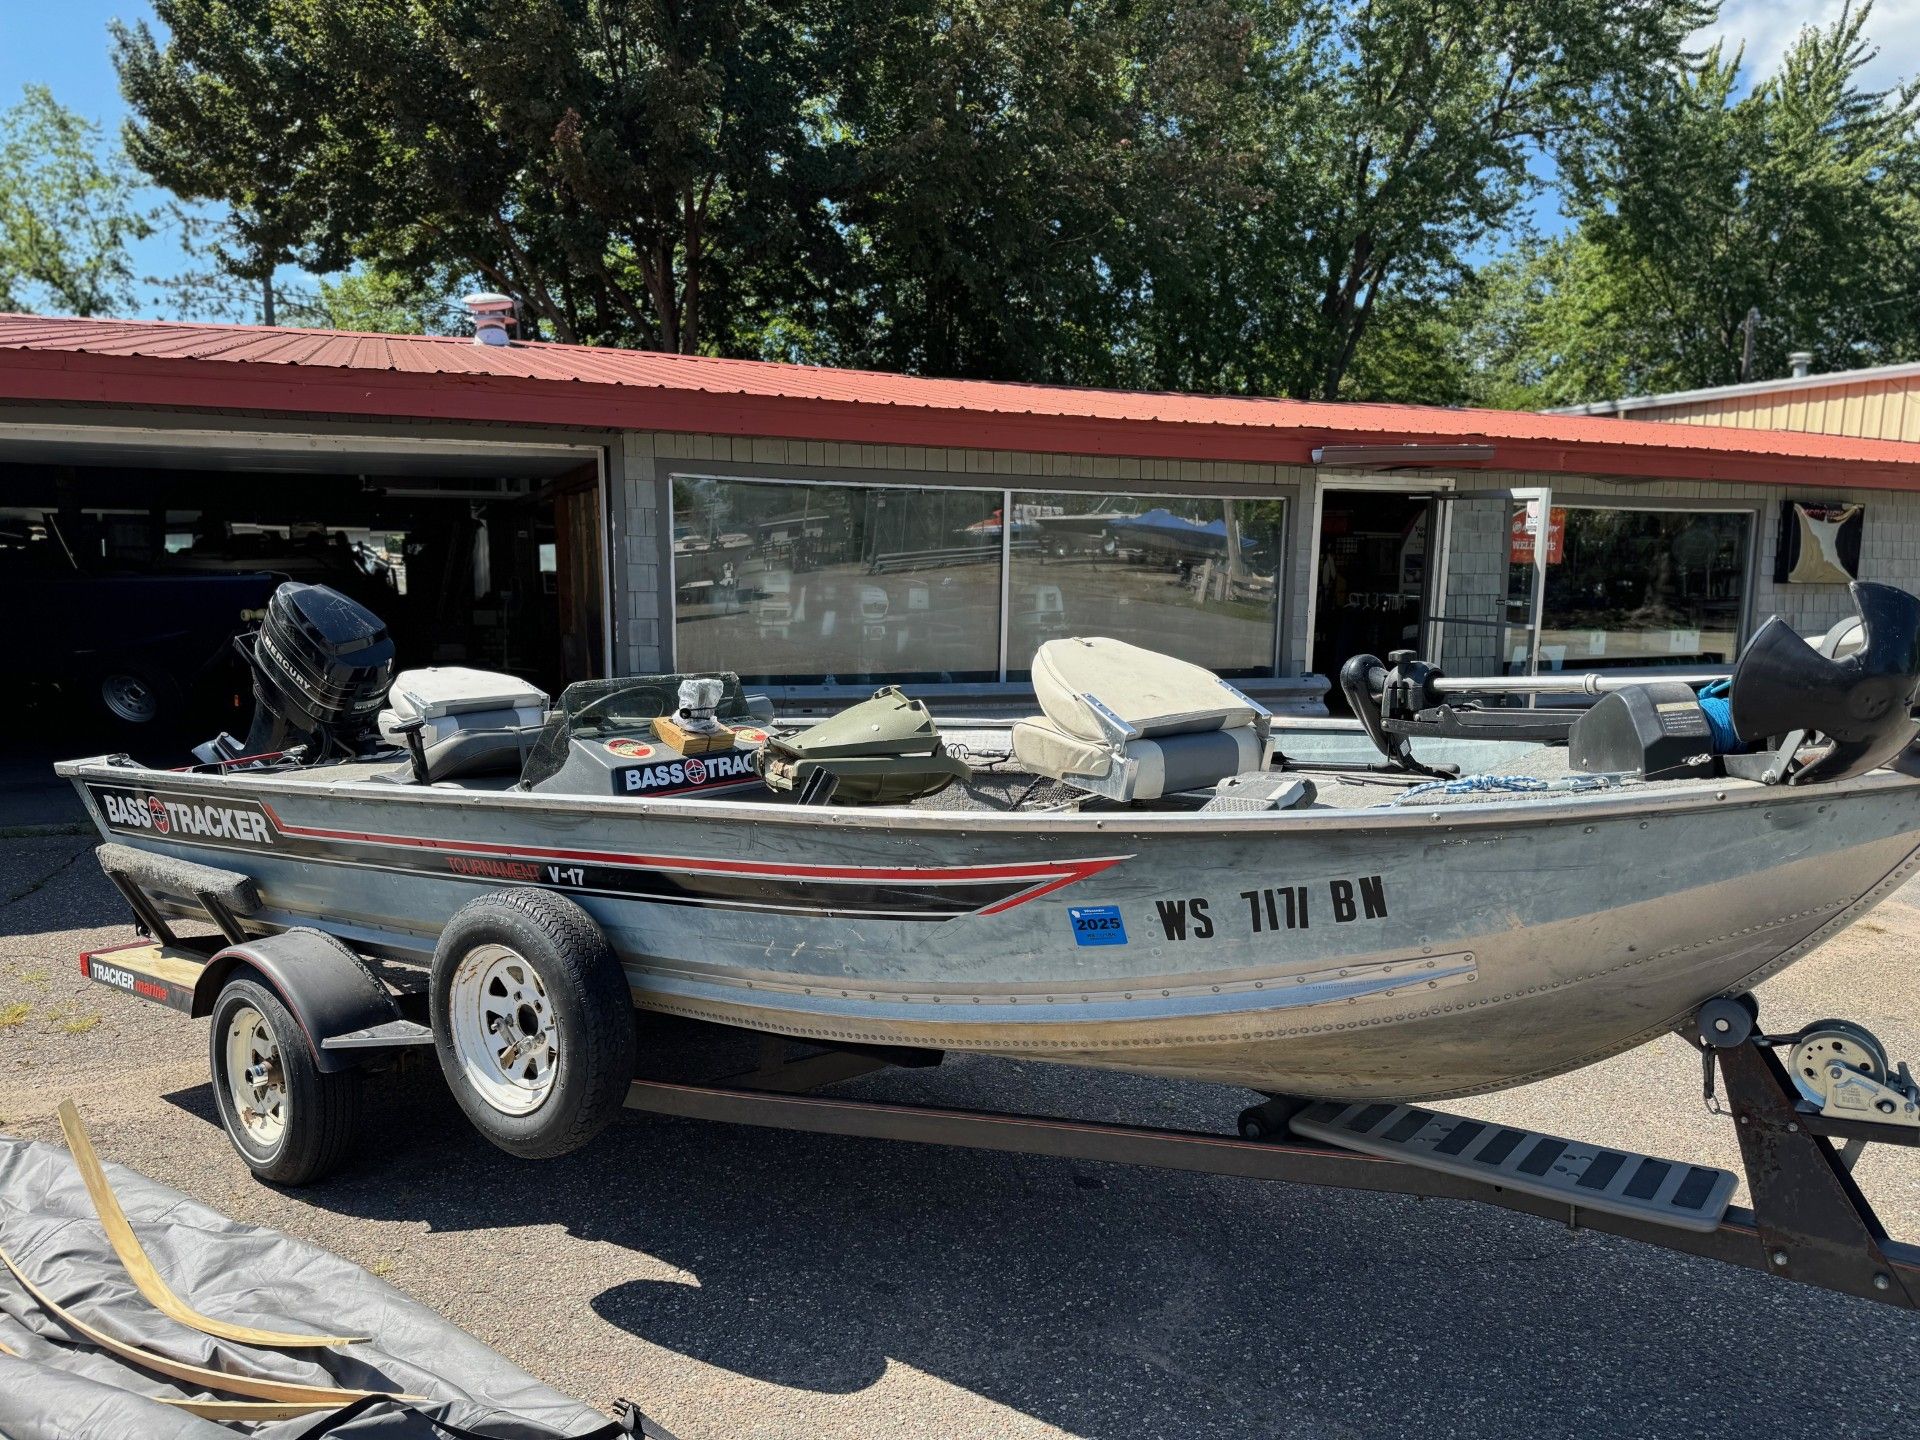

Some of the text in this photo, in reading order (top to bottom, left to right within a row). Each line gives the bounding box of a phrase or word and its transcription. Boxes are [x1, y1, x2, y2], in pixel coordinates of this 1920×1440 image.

[264, 635, 311, 690] MERCURY
[625, 753, 754, 791] BASS TRAC
[103, 794, 273, 844] BASS TRACKER
[445, 856, 584, 886] TOURNAMENT V-17
[1076, 917, 1121, 931] 2025
[1155, 875, 1388, 941] WS 7171 BN
[92, 963, 168, 1001] TRACKER marine
